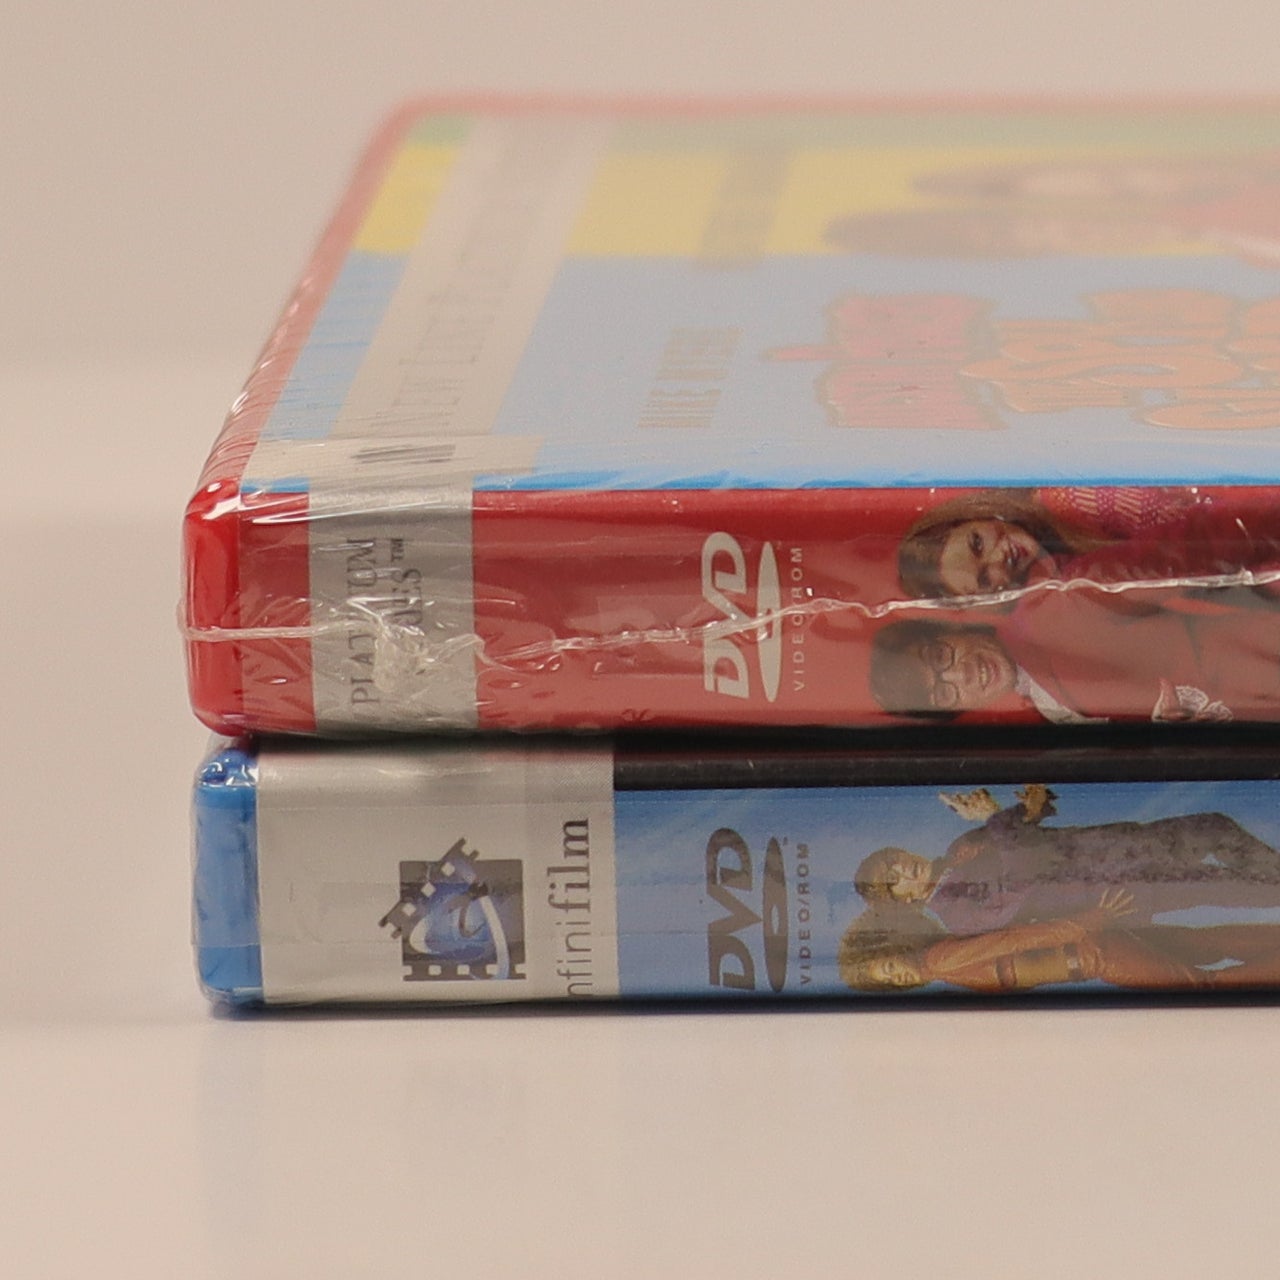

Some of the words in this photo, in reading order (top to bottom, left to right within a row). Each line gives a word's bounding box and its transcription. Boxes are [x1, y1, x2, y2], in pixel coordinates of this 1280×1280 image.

[702, 531, 750, 700] DVD
[792, 547, 805, 691] VIDEOROM
[705, 827, 759, 992] DVD
